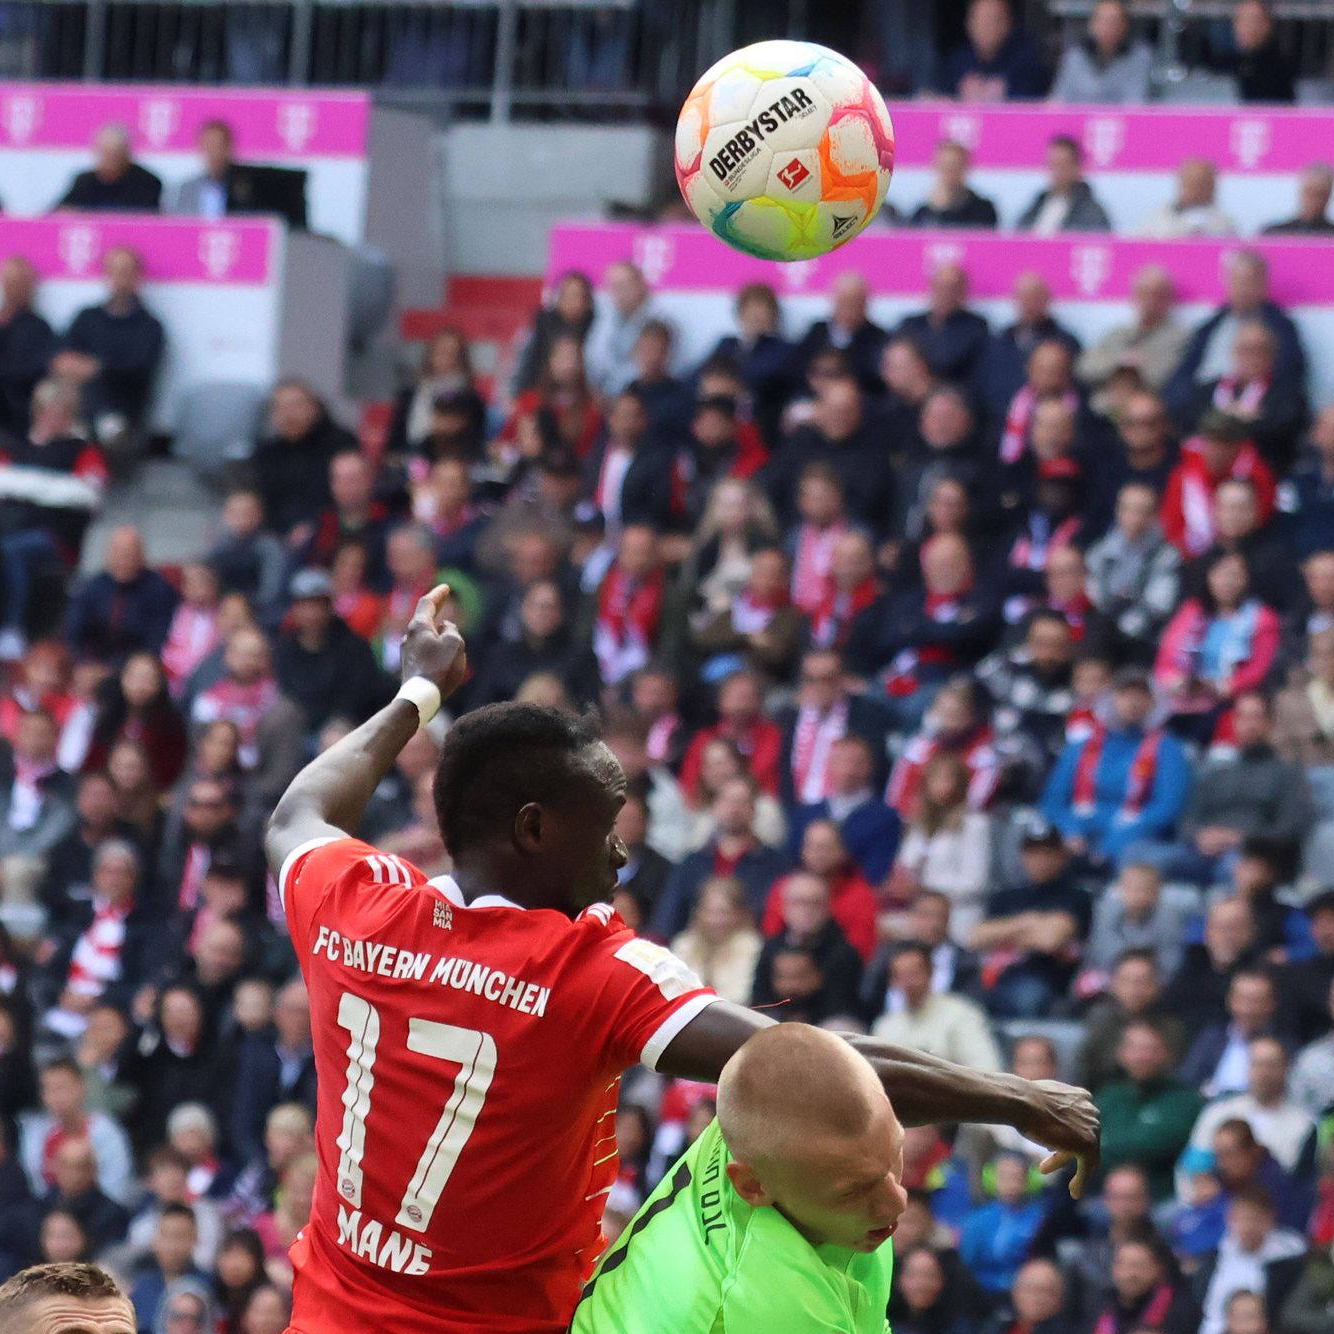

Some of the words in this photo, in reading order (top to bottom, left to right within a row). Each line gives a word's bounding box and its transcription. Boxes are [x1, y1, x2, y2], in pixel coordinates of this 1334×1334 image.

[709, 88, 813, 181] DERBYSTAR
[728, 147, 762, 183] BUNDESLIGA
[432, 917, 452, 931] MIA
[433, 908, 453, 922] SAN
[313, 925, 341, 962] FC
[342, 937, 432, 981] BAYERN
[429, 956, 552, 1018] MÜNCHEN
[337, 992, 498, 1234] 17
